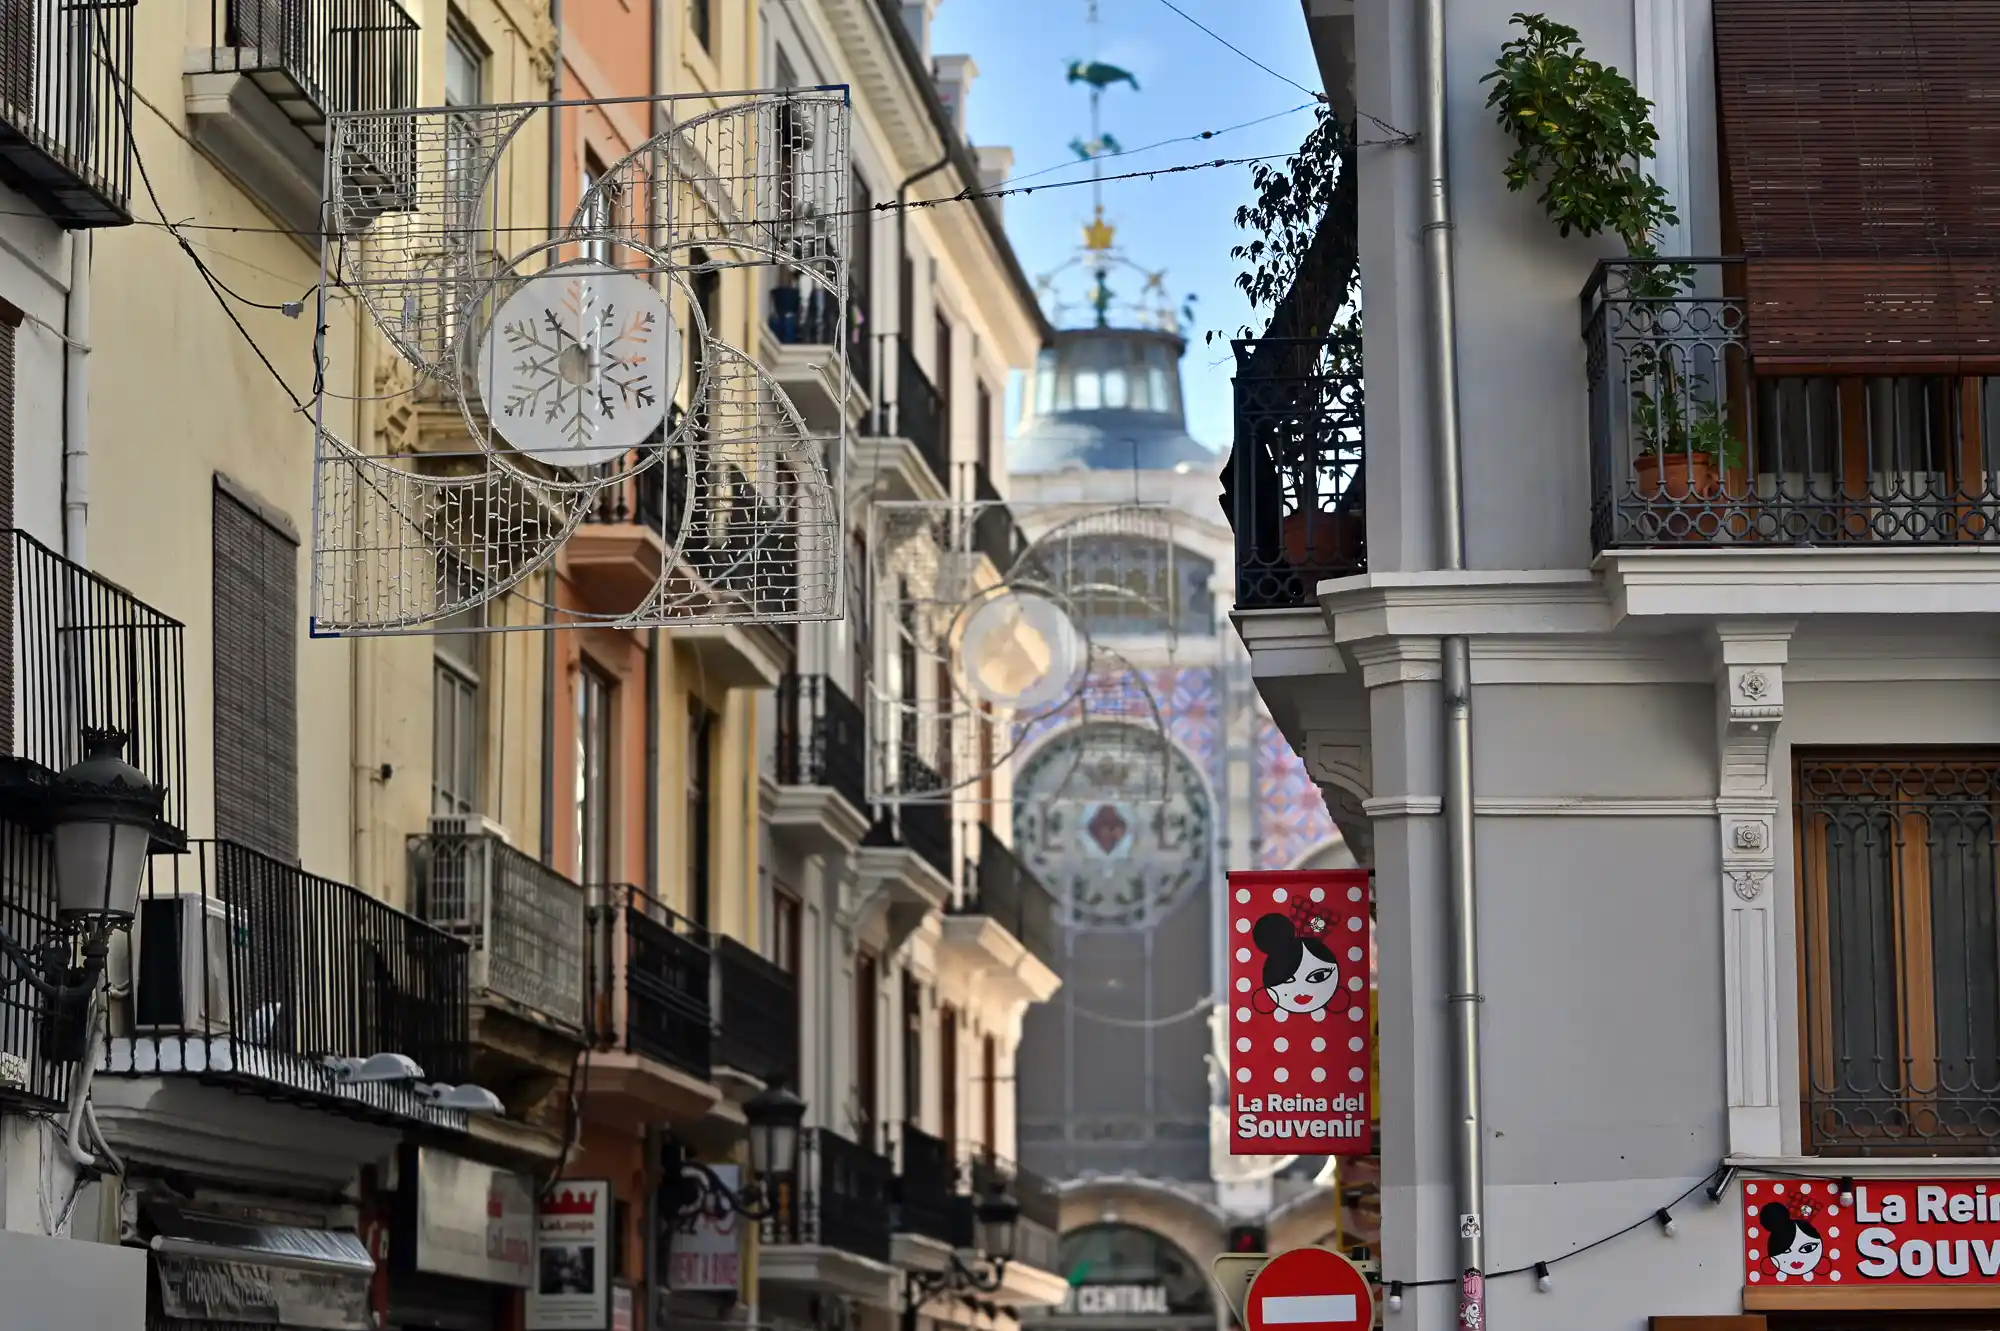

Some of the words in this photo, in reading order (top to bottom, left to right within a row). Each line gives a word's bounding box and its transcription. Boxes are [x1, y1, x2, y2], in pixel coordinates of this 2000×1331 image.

[1237, 1094, 1263, 1113] La
[1268, 1092, 1328, 1113] Reina
[1332, 1092, 1365, 1112] del
[1237, 1114, 1365, 1139] Souvenir
[1855, 1186, 1907, 1224] La
[1077, 1284, 1169, 1314] CENTRAL
